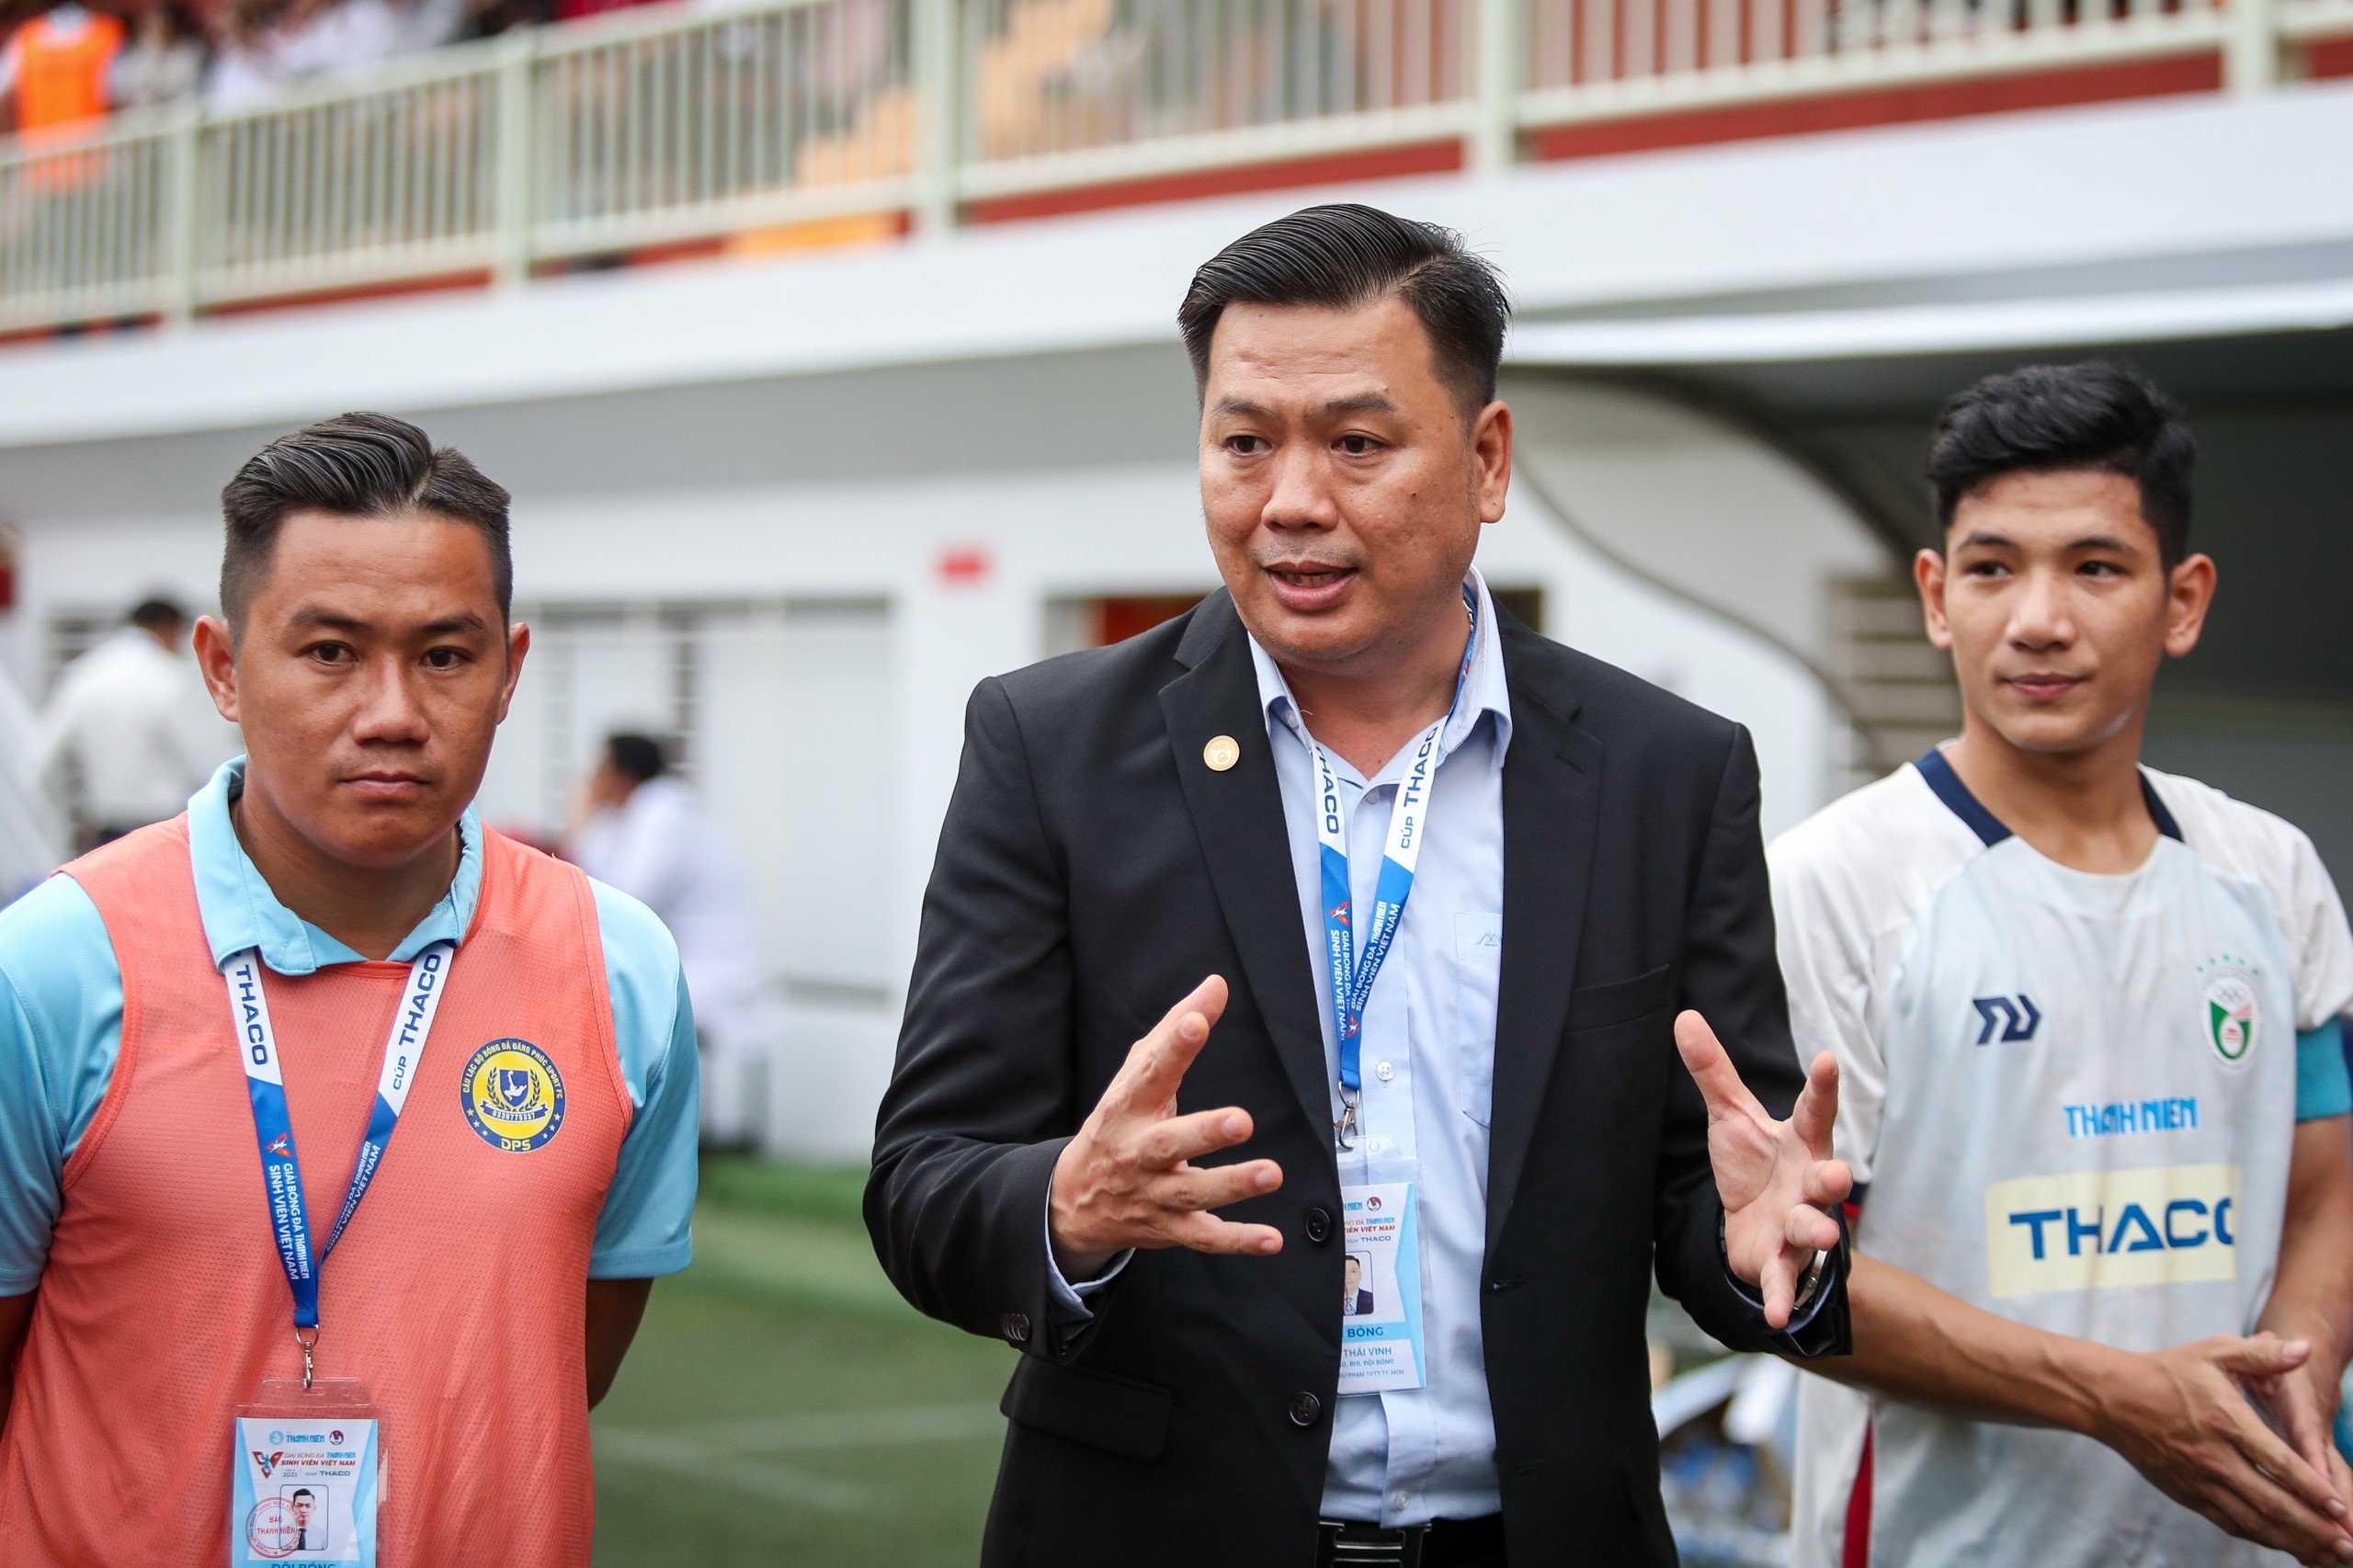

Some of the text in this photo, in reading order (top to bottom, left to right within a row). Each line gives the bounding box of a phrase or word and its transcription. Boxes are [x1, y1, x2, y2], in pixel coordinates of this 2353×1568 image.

[1401, 726, 1438, 849] CÚP THACO
[1331, 929, 1341, 958] SINH
[1342, 930, 1350, 952] GIẢI
[1333, 959, 1344, 986] VIÊN
[1343, 952, 1352, 983] BÓNG
[1356, 903, 1401, 1012] SINH VIÊN VIỆT NAM
[1356, 961, 1371, 989] BÓNG
[1367, 946, 1377, 961] ĐÁ
[236, 964, 269, 1065] THACO
[1336, 987, 1346, 1011] VIỆT
[392, 953, 442, 1091] CÚP THACO
[483, 1043, 501, 1056] BÓNG
[501, 1040, 511, 1050] ĐÁ
[545, 1065, 561, 1087] SPORT
[556, 1087, 563, 1099] FC
[366, 1144, 381, 1176] NAM
[501, 1138, 531, 1151] DPS
[283, 1163, 297, 1185] GIẢI
[287, 1185, 301, 1217] BÓNG
[269, 1165, 300, 1280] SINH VIÊN VIỆT NAM
[292, 1217, 305, 1233] ĐÁ
[1347, 1325, 1384, 1338] BÓNG
[1344, 1346, 1392, 1358] THÁI VINH
